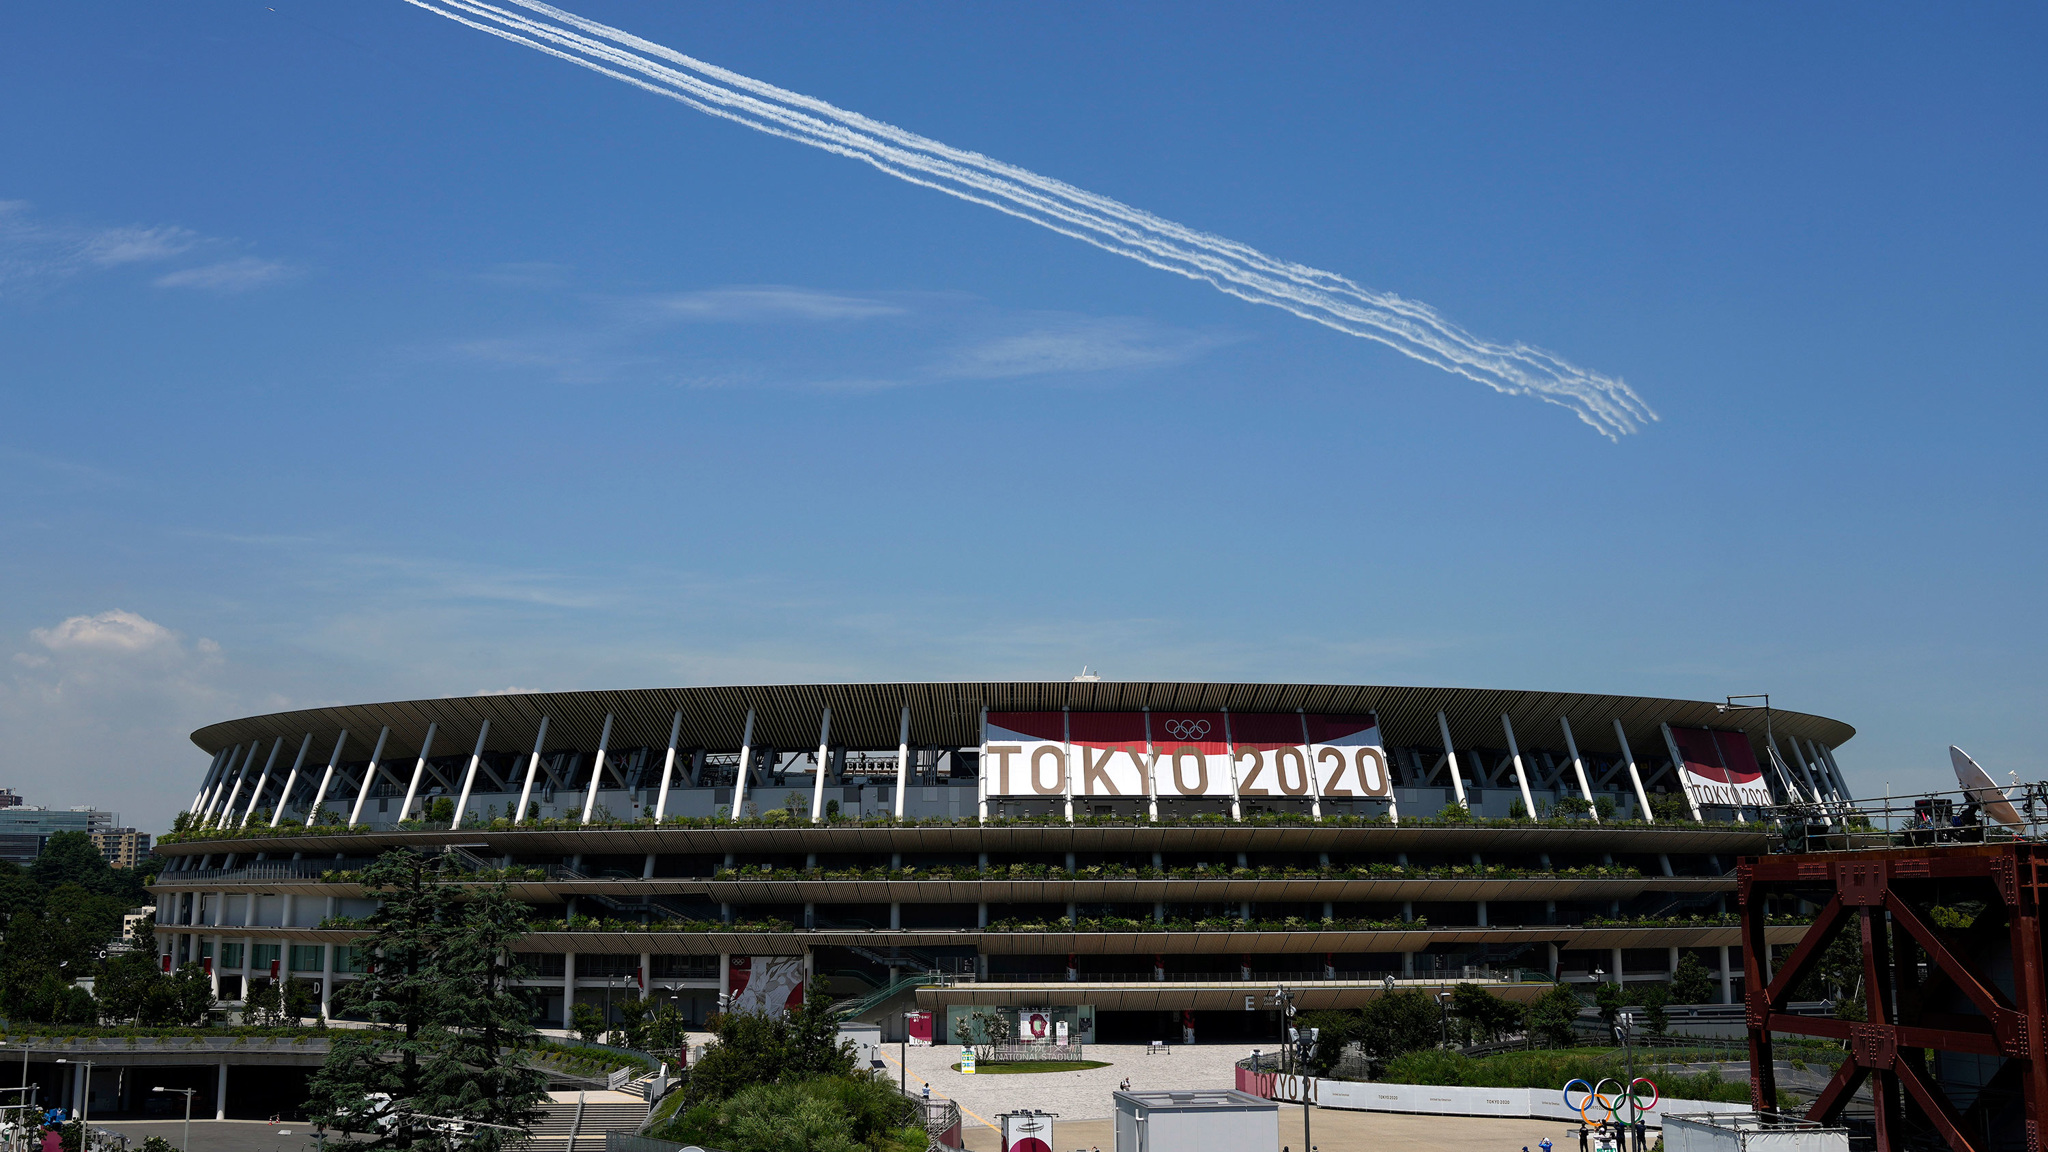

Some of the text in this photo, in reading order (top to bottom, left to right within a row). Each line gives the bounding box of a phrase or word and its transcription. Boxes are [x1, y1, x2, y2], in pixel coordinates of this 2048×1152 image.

[987, 744, 1389, 797] TOKYO 2020
[1693, 784, 1774, 807] TOKYO 2020
[99, 950, 107, 959] C
[313, 981, 321, 995] D
[1245, 996, 1256, 1012] E
[995, 1053, 1082, 1062] NATIONAL STADIUM
[1253, 1072, 1298, 1101] TOKYO
